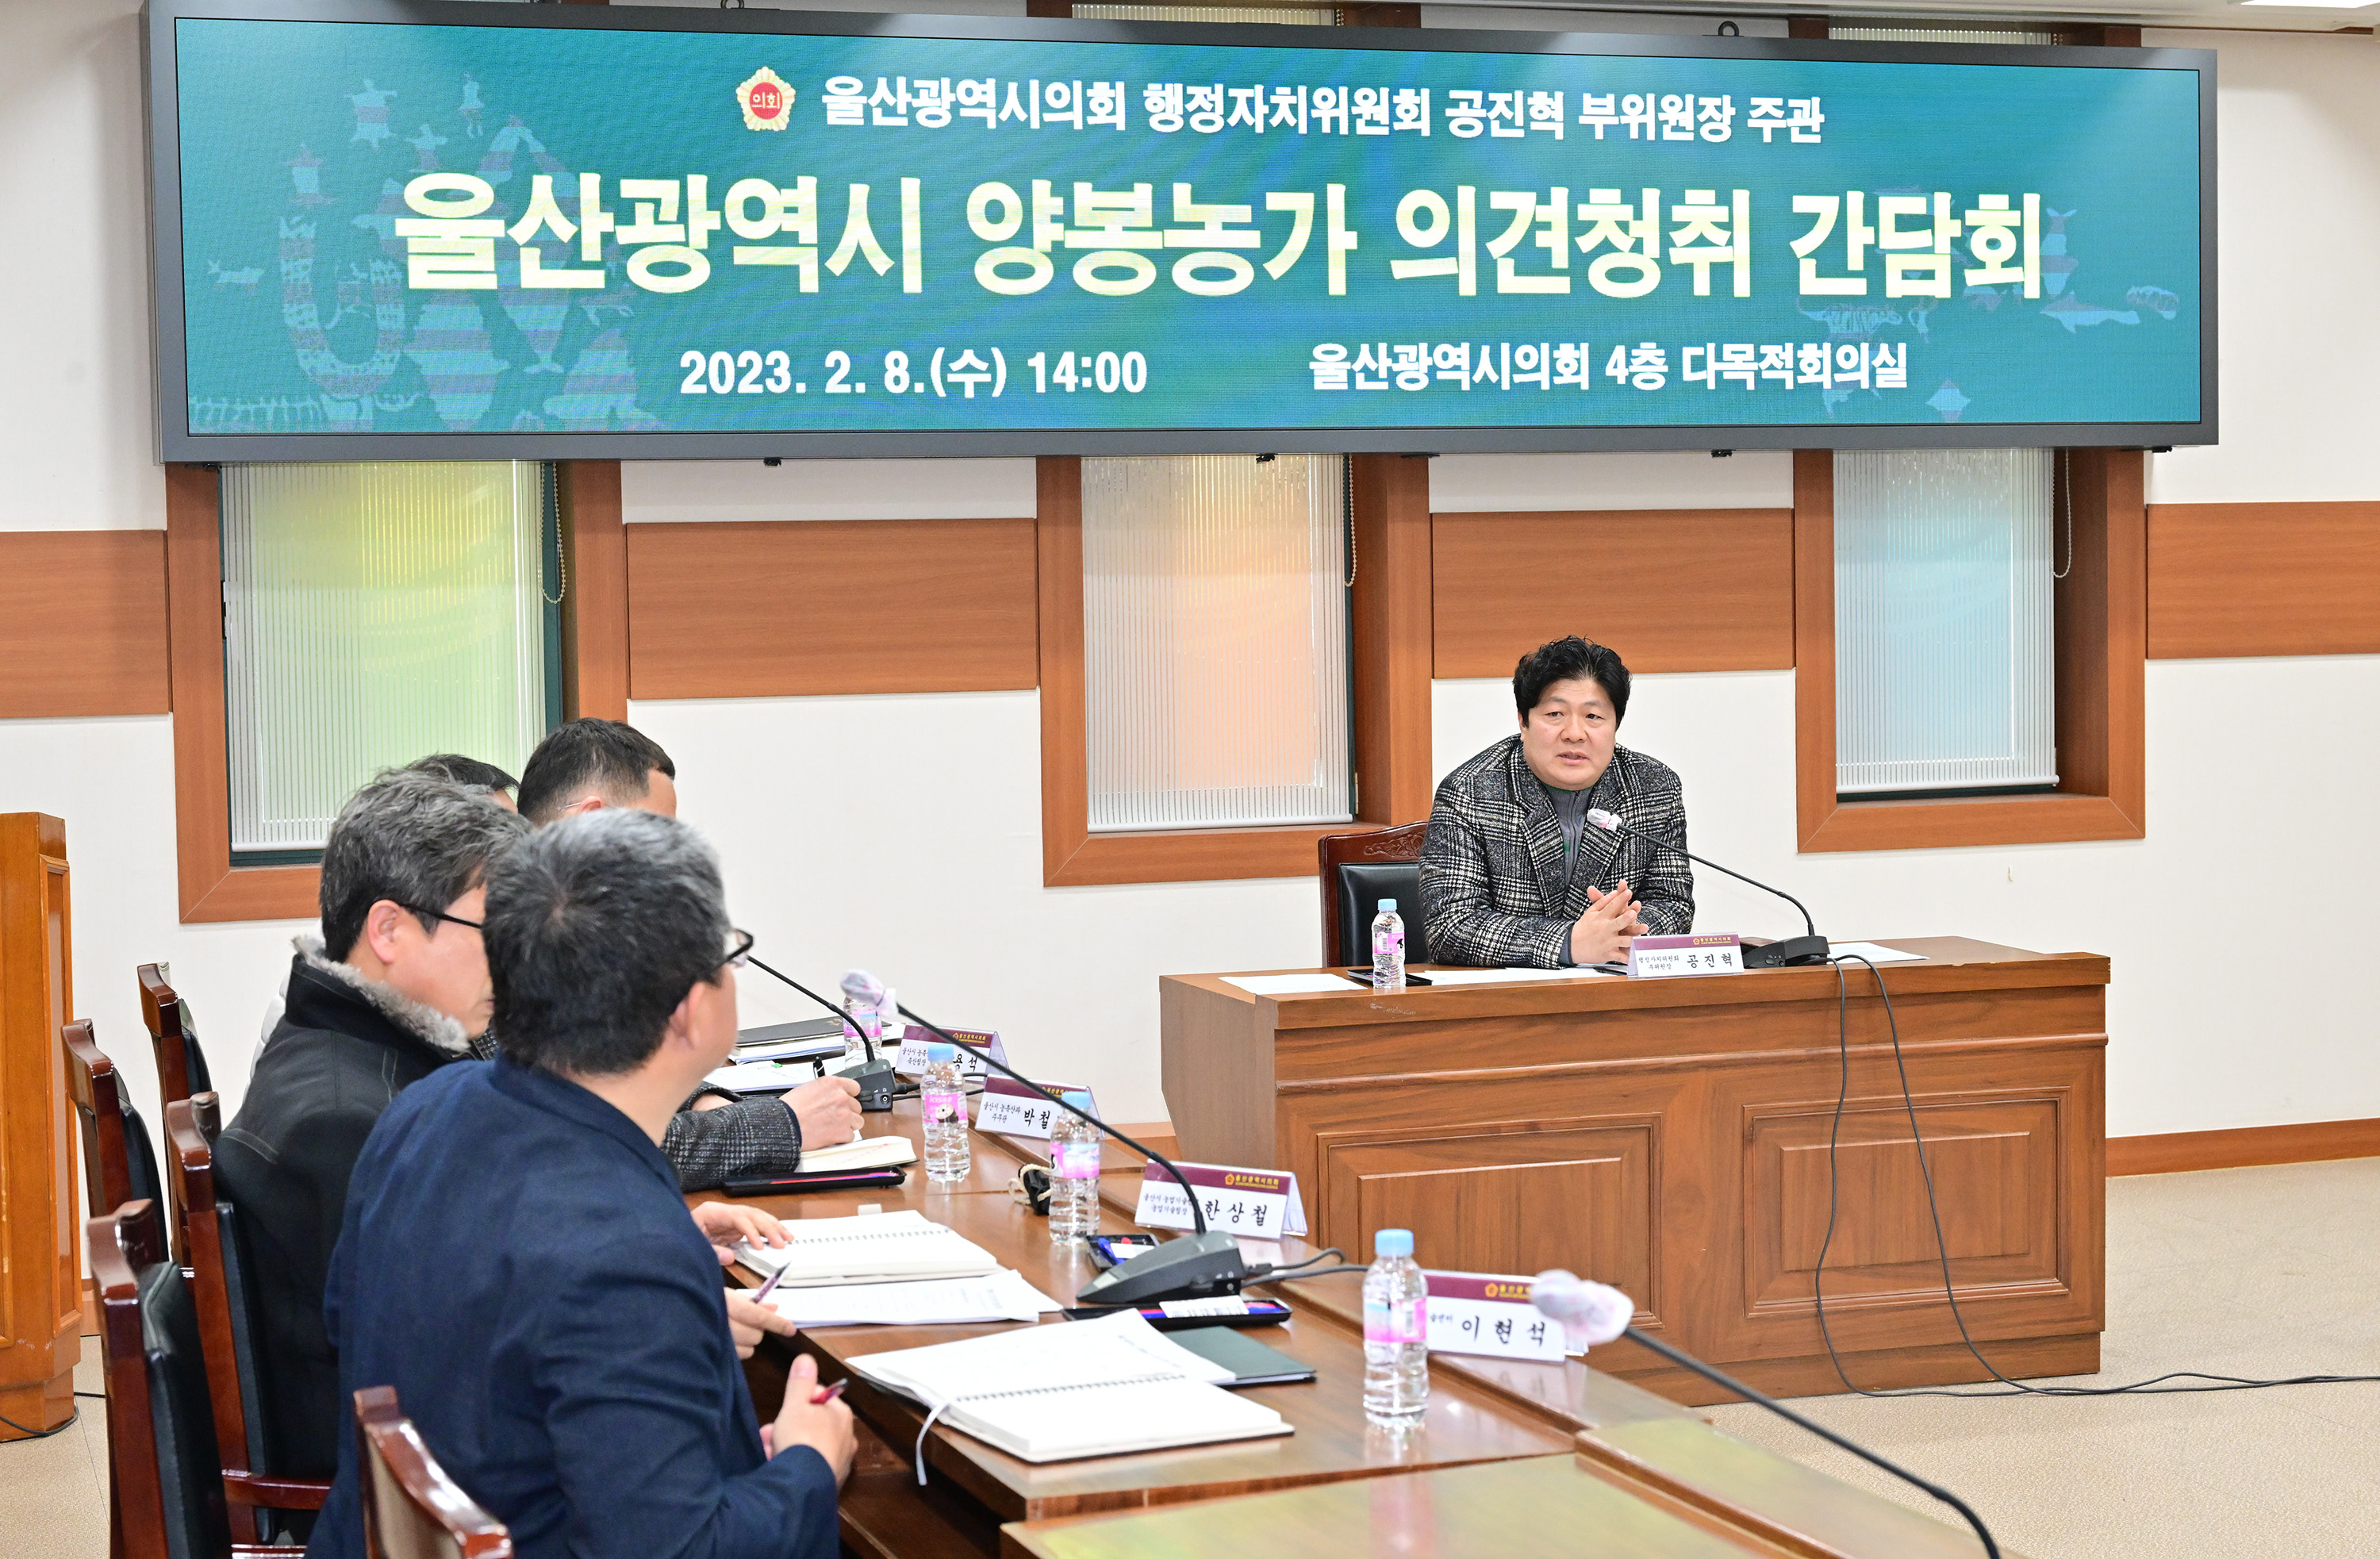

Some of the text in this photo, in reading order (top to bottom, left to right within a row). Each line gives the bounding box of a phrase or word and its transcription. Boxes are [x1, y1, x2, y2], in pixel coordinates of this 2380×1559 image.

[752, 91, 781, 109] 의회
[822, 76, 1826, 144] 울산광역시의회 행정자치위원회 공진혁 부위원장 주관
[395, 172, 2042, 300] 울산광역시 양봉농가 의견청취 간담회
[680, 348, 1149, 399] 2023. 2. 8.(수) 14:00
[1309, 342, 1909, 392] 울산광역시의회 4층 다목적회의실
[1638, 954, 1679, 963] 행정자치위원회
[1023, 1108, 1060, 1130] 박철
